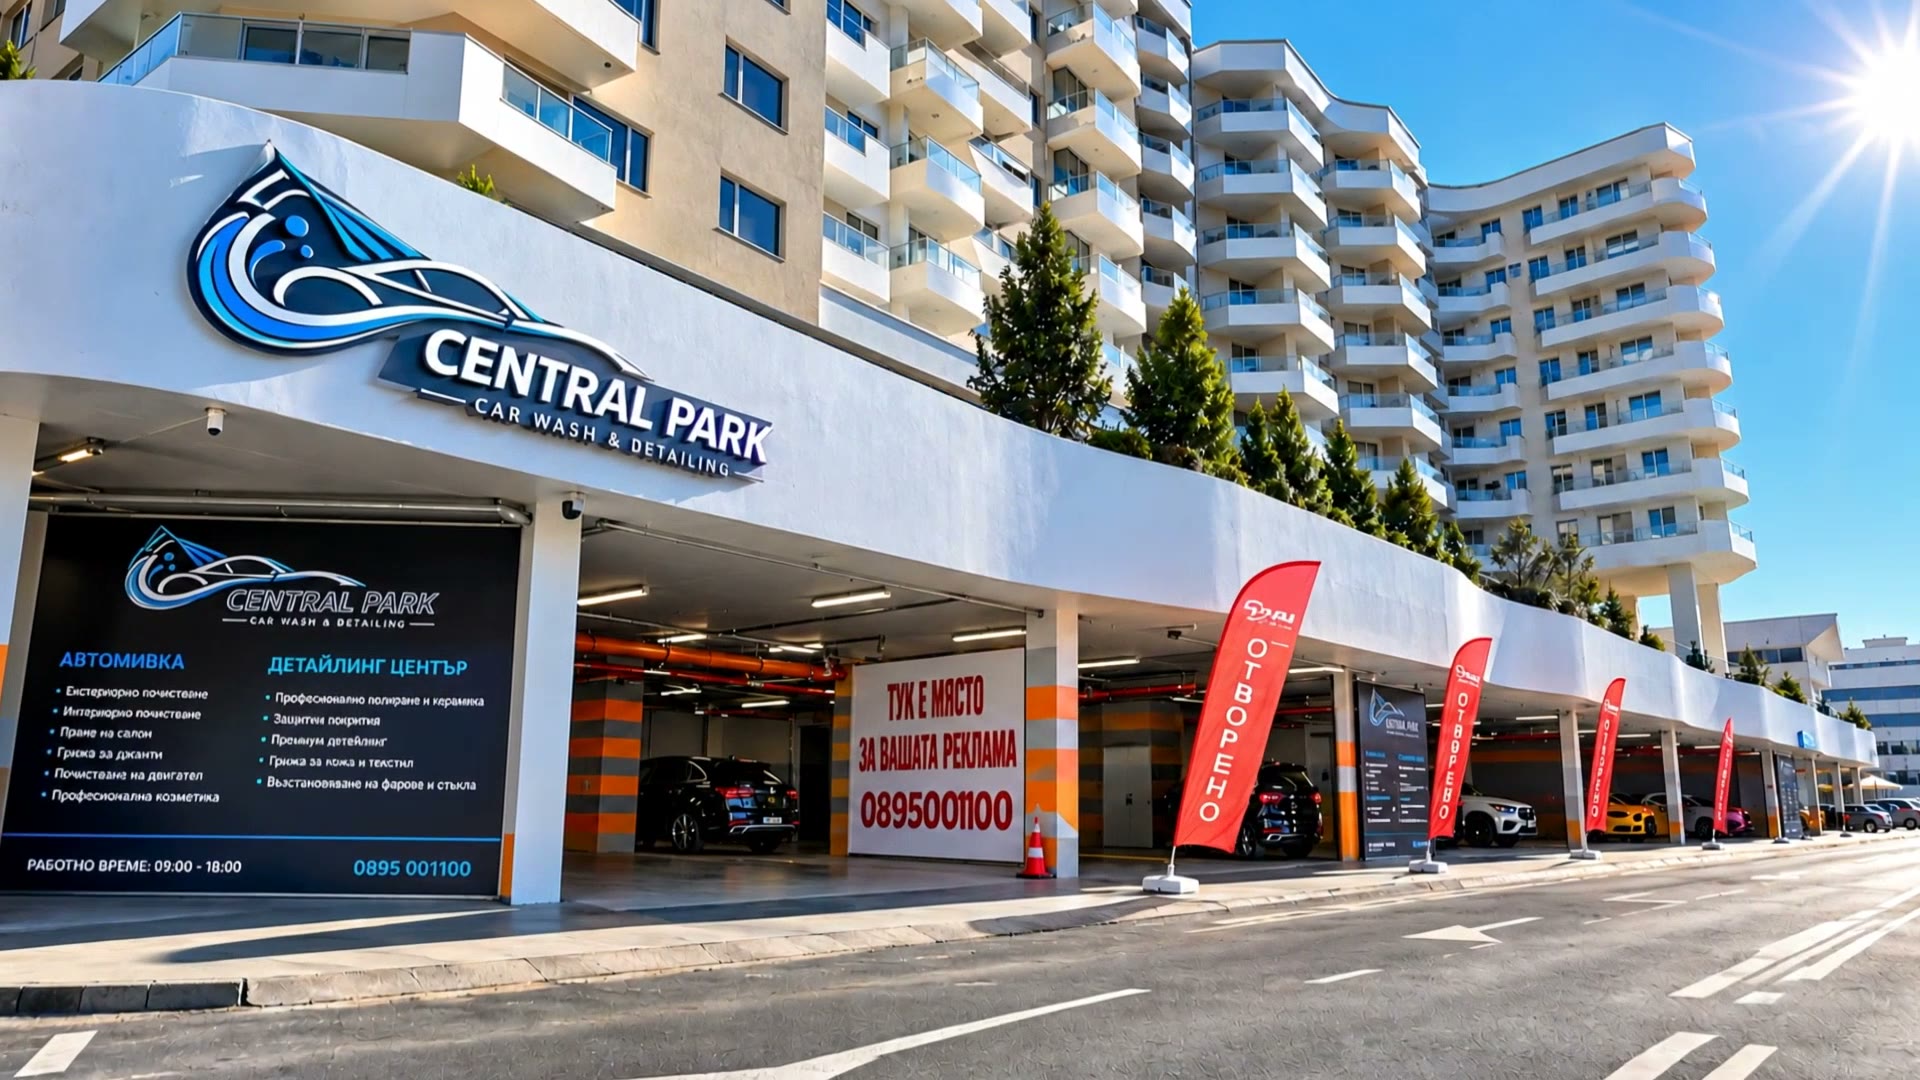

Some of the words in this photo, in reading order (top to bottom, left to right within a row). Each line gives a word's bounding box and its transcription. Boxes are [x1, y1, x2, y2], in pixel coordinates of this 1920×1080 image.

[424, 328, 654, 431] CENTRAL
[665, 396, 773, 465] PARK
[474, 397, 520, 424] CAR
[533, 412, 596, 443] WASH
[608, 432, 620, 449] &
[631, 437, 729, 477] DETAILING
[226, 588, 354, 614] CENTRAL
[361, 591, 440, 615] PARK
[249, 616, 274, 626] CAR
[280, 617, 316, 627] WASH
[336, 618, 405, 629] DETAILING
[59, 651, 185, 670] АВТОМИВКА
[267, 654, 386, 675] ДЕТАЙЛИНГ
[390, 658, 468, 677] ЦЕНТЪР
[275, 691, 365, 706] Професионално
[367, 694, 421, 707] полиране
[423, 696, 430, 706] и
[432, 696, 485, 709] керамика
[887, 682, 915, 721] ТУК
[918, 679, 927, 719] Е
[931, 674, 984, 718] МЯСТО
[60, 726, 97, 740] Пране
[100, 729, 114, 739] на
[117, 729, 152, 739] салон
[1199, 638, 1268, 822] ОТВОРЕНО
[115, 750, 163, 761] джанти
[859, 736, 876, 772] ЗА
[879, 733, 938, 771] ВАШАТА
[943, 729, 1017, 770] РЕКЛАМА
[268, 755, 307, 768] Грижа
[309, 757, 322, 767] за
[358, 758, 366, 768] и
[368, 758, 414, 769] текстил
[54, 768, 127, 781] Почистване
[130, 771, 146, 781] на
[147, 771, 203, 782] двигател
[364, 779, 379, 790] на
[381, 778, 425, 792] фарове
[426, 781, 435, 791] и
[437, 780, 477, 791] стъкла
[51, 789, 152, 803] Професионална
[155, 792, 220, 803] козметика
[860, 790, 1013, 832] 0895001100
[27, 858, 95, 872] РАБОТНО
[98, 859, 151, 873] ВРЕМЕ:
[154, 859, 193, 873] 09:00
[205, 860, 242, 873] 18:00
[353, 859, 400, 877] 0895
[405, 859, 472, 878] 001100
